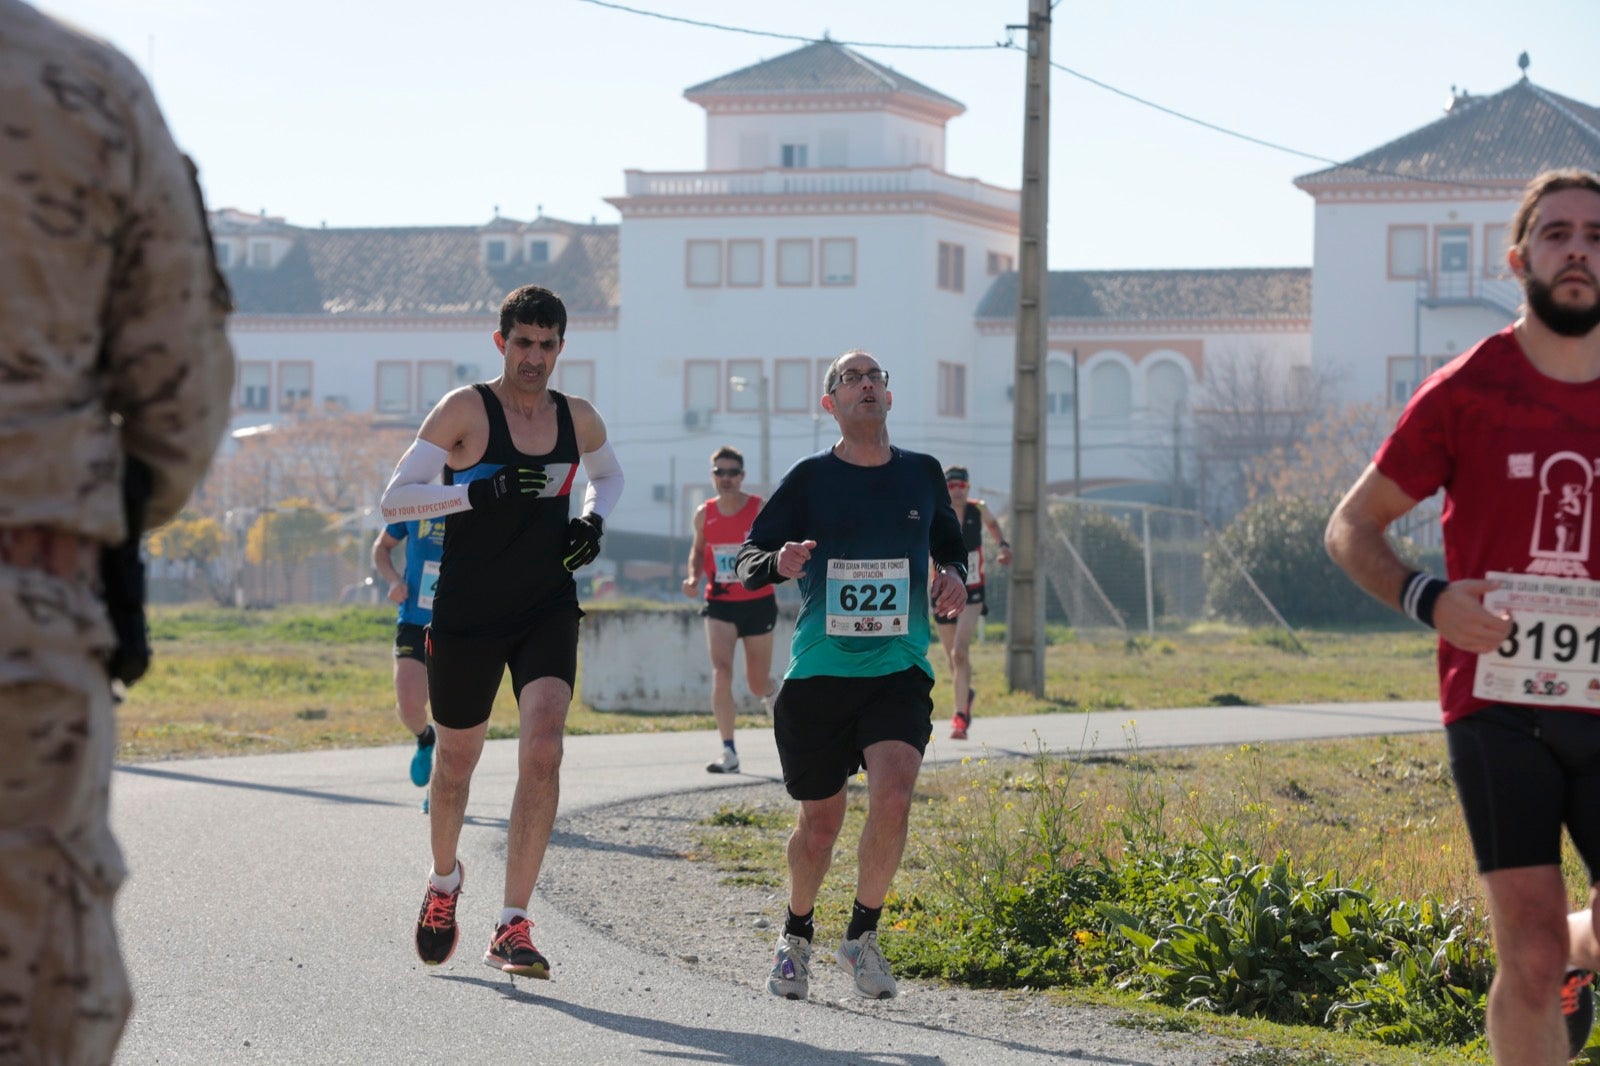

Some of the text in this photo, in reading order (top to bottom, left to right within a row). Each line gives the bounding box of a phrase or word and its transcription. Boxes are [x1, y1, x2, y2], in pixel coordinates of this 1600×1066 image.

[399, 505, 416, 515] YOUR
[417, 497, 462, 514] EXPECTATIONS
[888, 561, 904, 569] FONDO
[840, 584, 897, 611] 622
[1498, 622, 1600, 663] 3191
